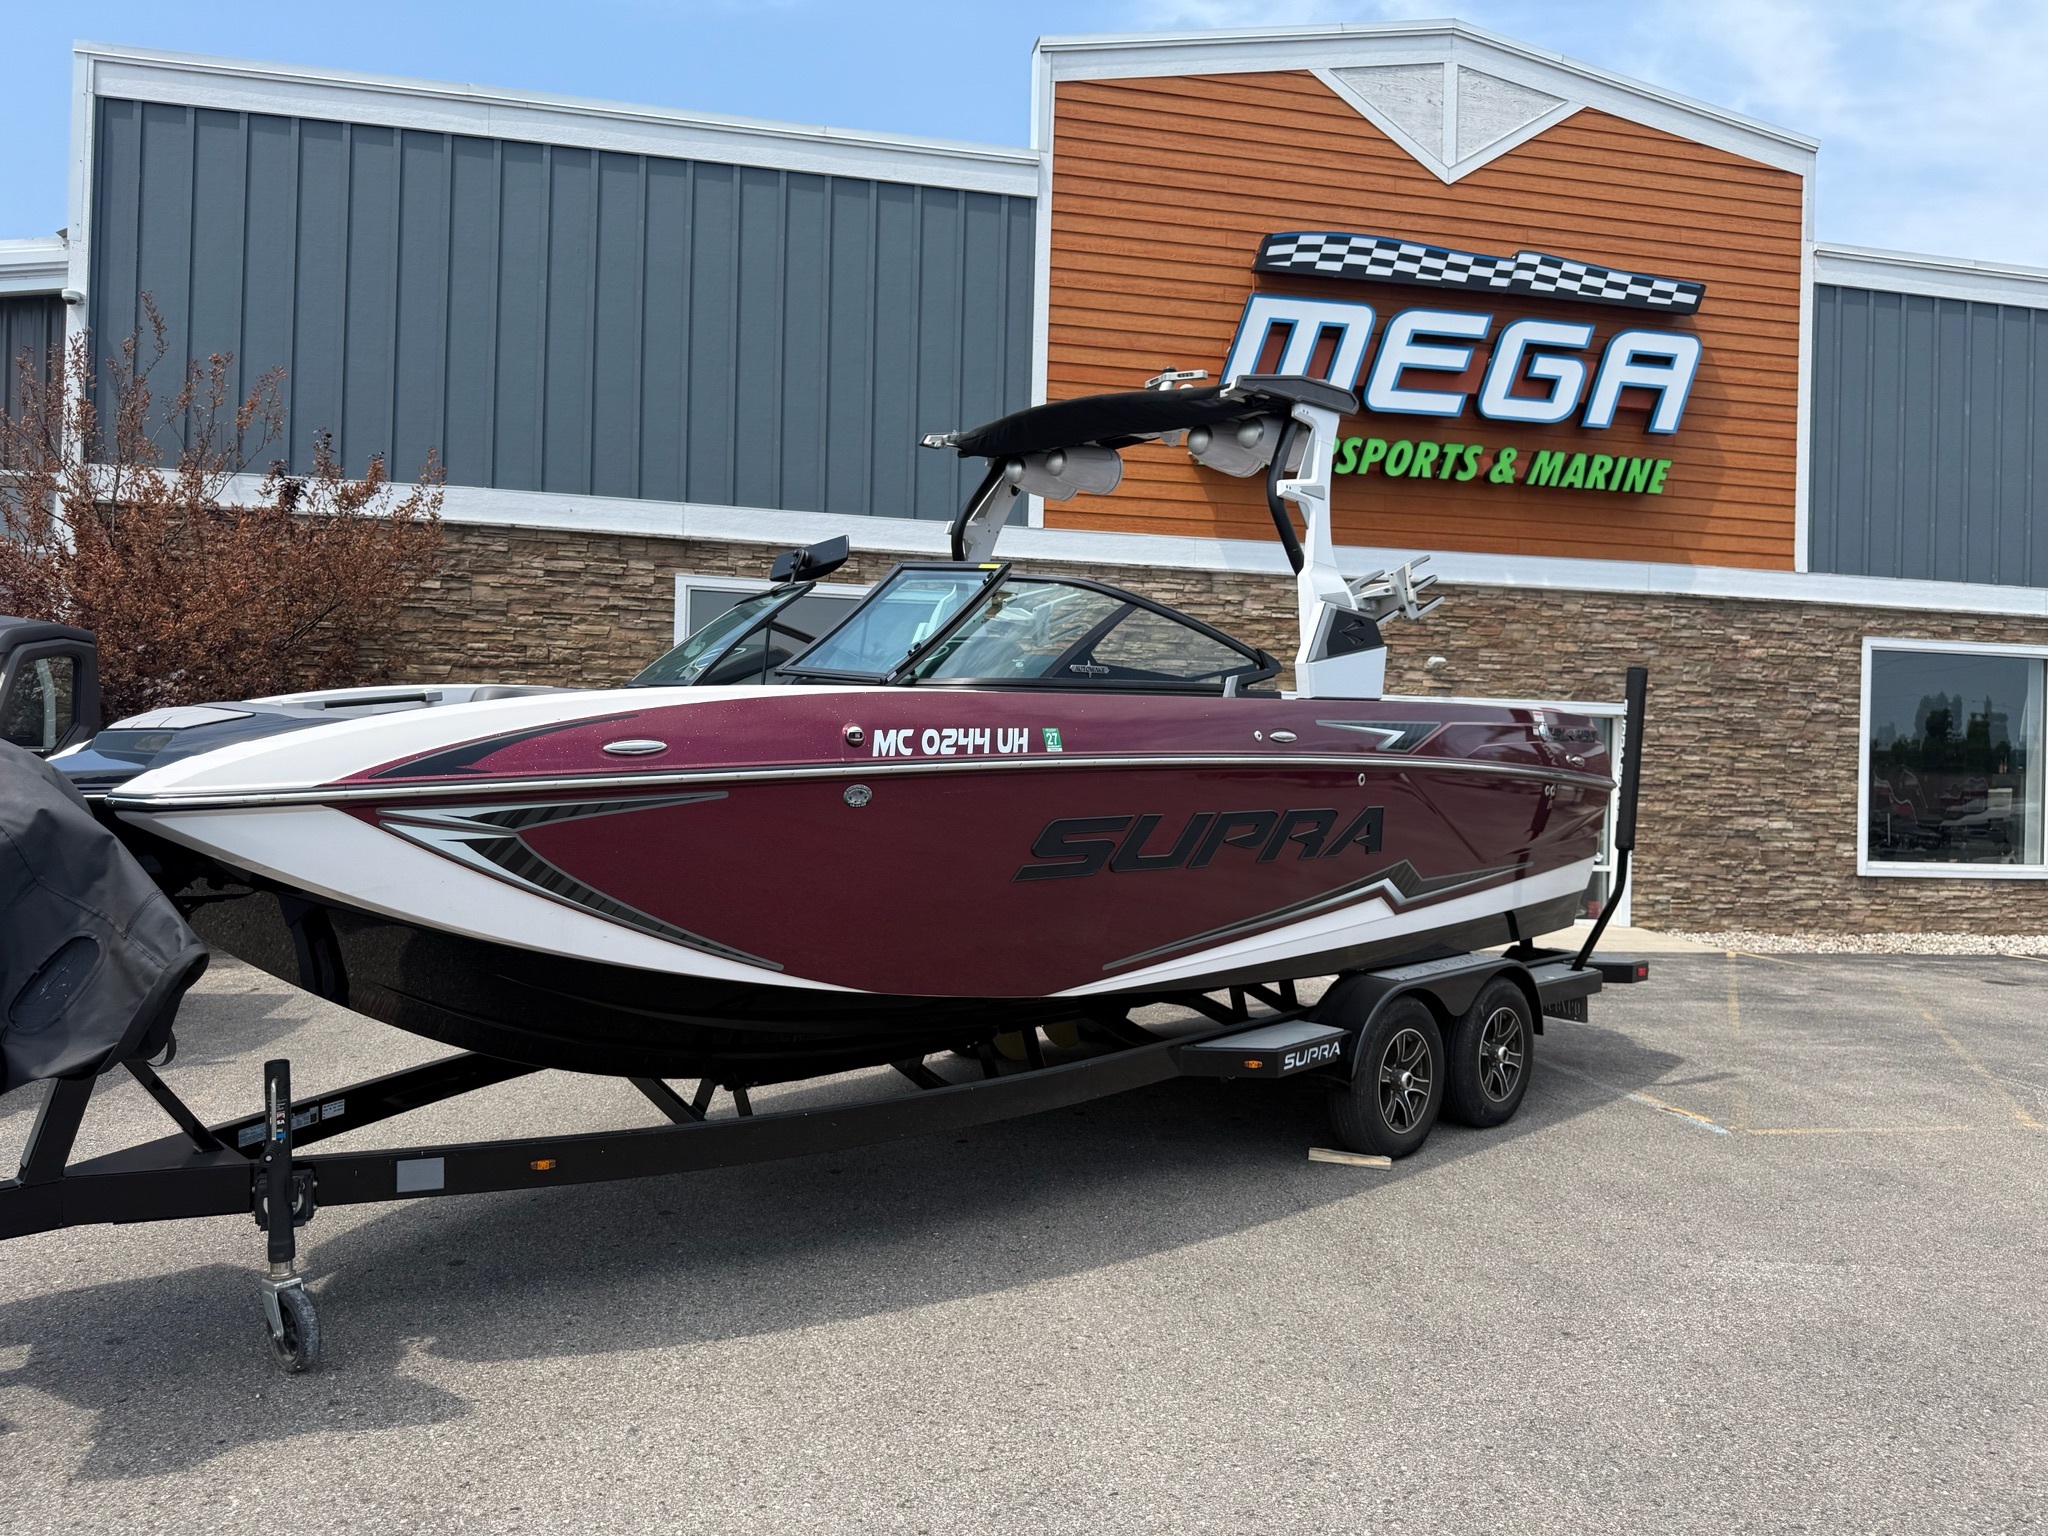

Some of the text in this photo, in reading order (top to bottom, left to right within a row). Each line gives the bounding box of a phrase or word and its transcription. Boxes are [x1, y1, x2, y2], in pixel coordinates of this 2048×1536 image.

[1220, 293, 1702, 434] MEGA
[1488, 446, 1517, 484] &
[1525, 449, 1673, 495] MARINE
[872, 727, 1029, 757] MC 0244 UH
[1046, 732, 1058, 745] 27
[1011, 805, 1385, 882] SUPRA
[1283, 1041, 1341, 1070] SUPRA
